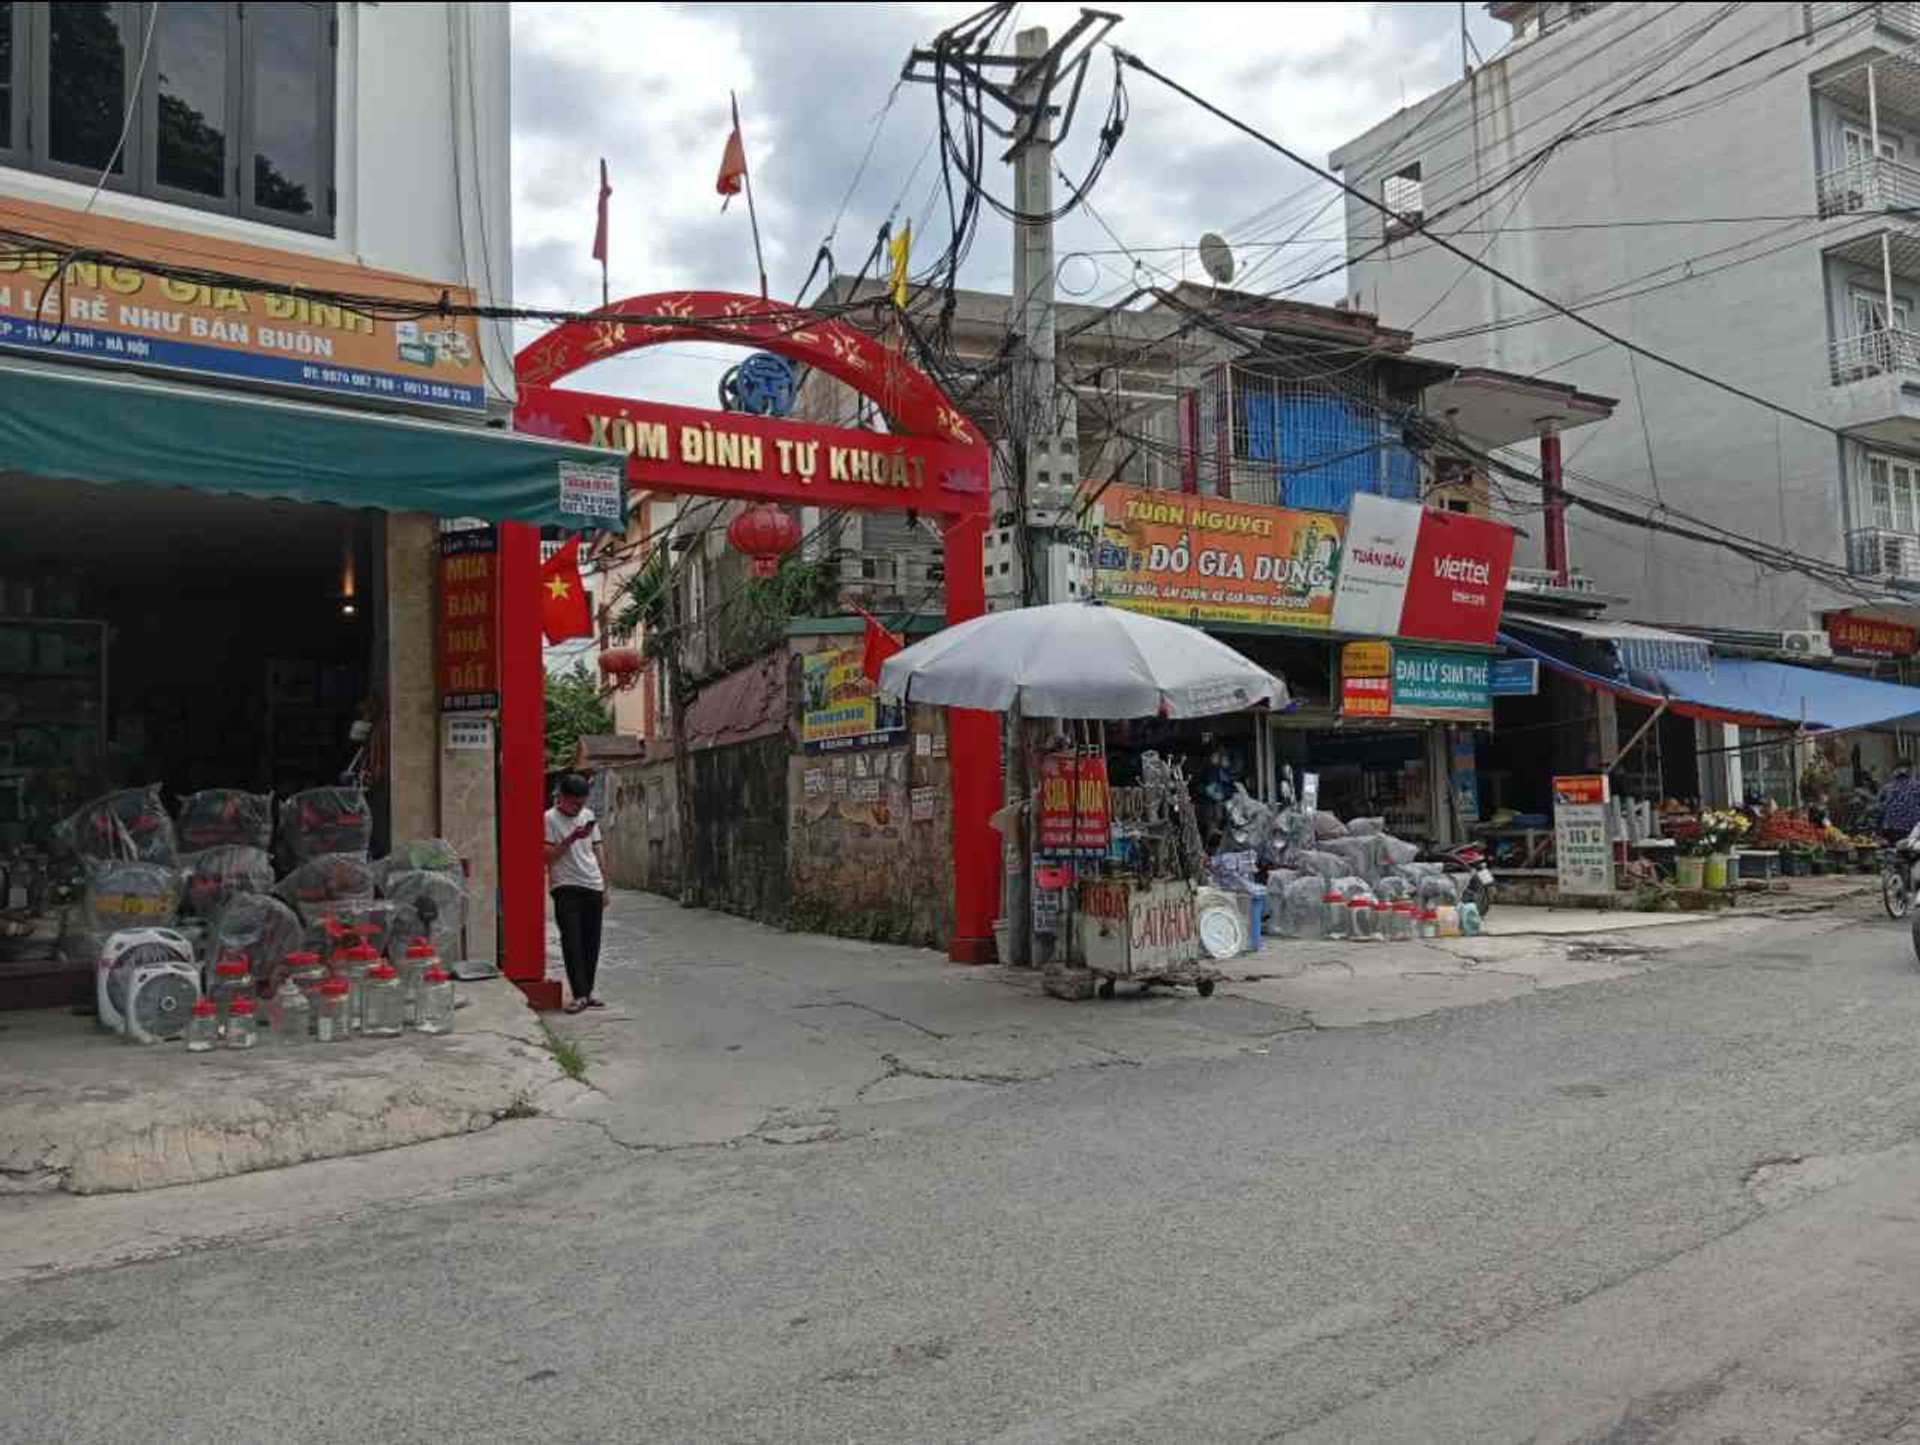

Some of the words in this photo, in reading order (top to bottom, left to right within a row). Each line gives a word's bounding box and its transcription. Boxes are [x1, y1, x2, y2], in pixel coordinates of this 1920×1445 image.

[120, 305, 183, 333] NHƯ
[190, 314, 249, 344] BÁN
[257, 327, 334, 357] BUÔN
[585, 408, 670, 461] XÓM
[681, 421, 763, 471] ĐÌNH
[776, 437, 820, 484] TỰ
[830, 446, 926, 489] KHOÁT
[446, 555, 488, 581] MUA
[1149, 529, 1190, 574] ĐỒ
[1198, 549, 1245, 579] GIA
[1251, 555, 1323, 590] DỤNG
[446, 590, 488, 618] BÁN
[1396, 660, 1421, 686] ĐẠI
[1440, 664, 1463, 685] SIM
